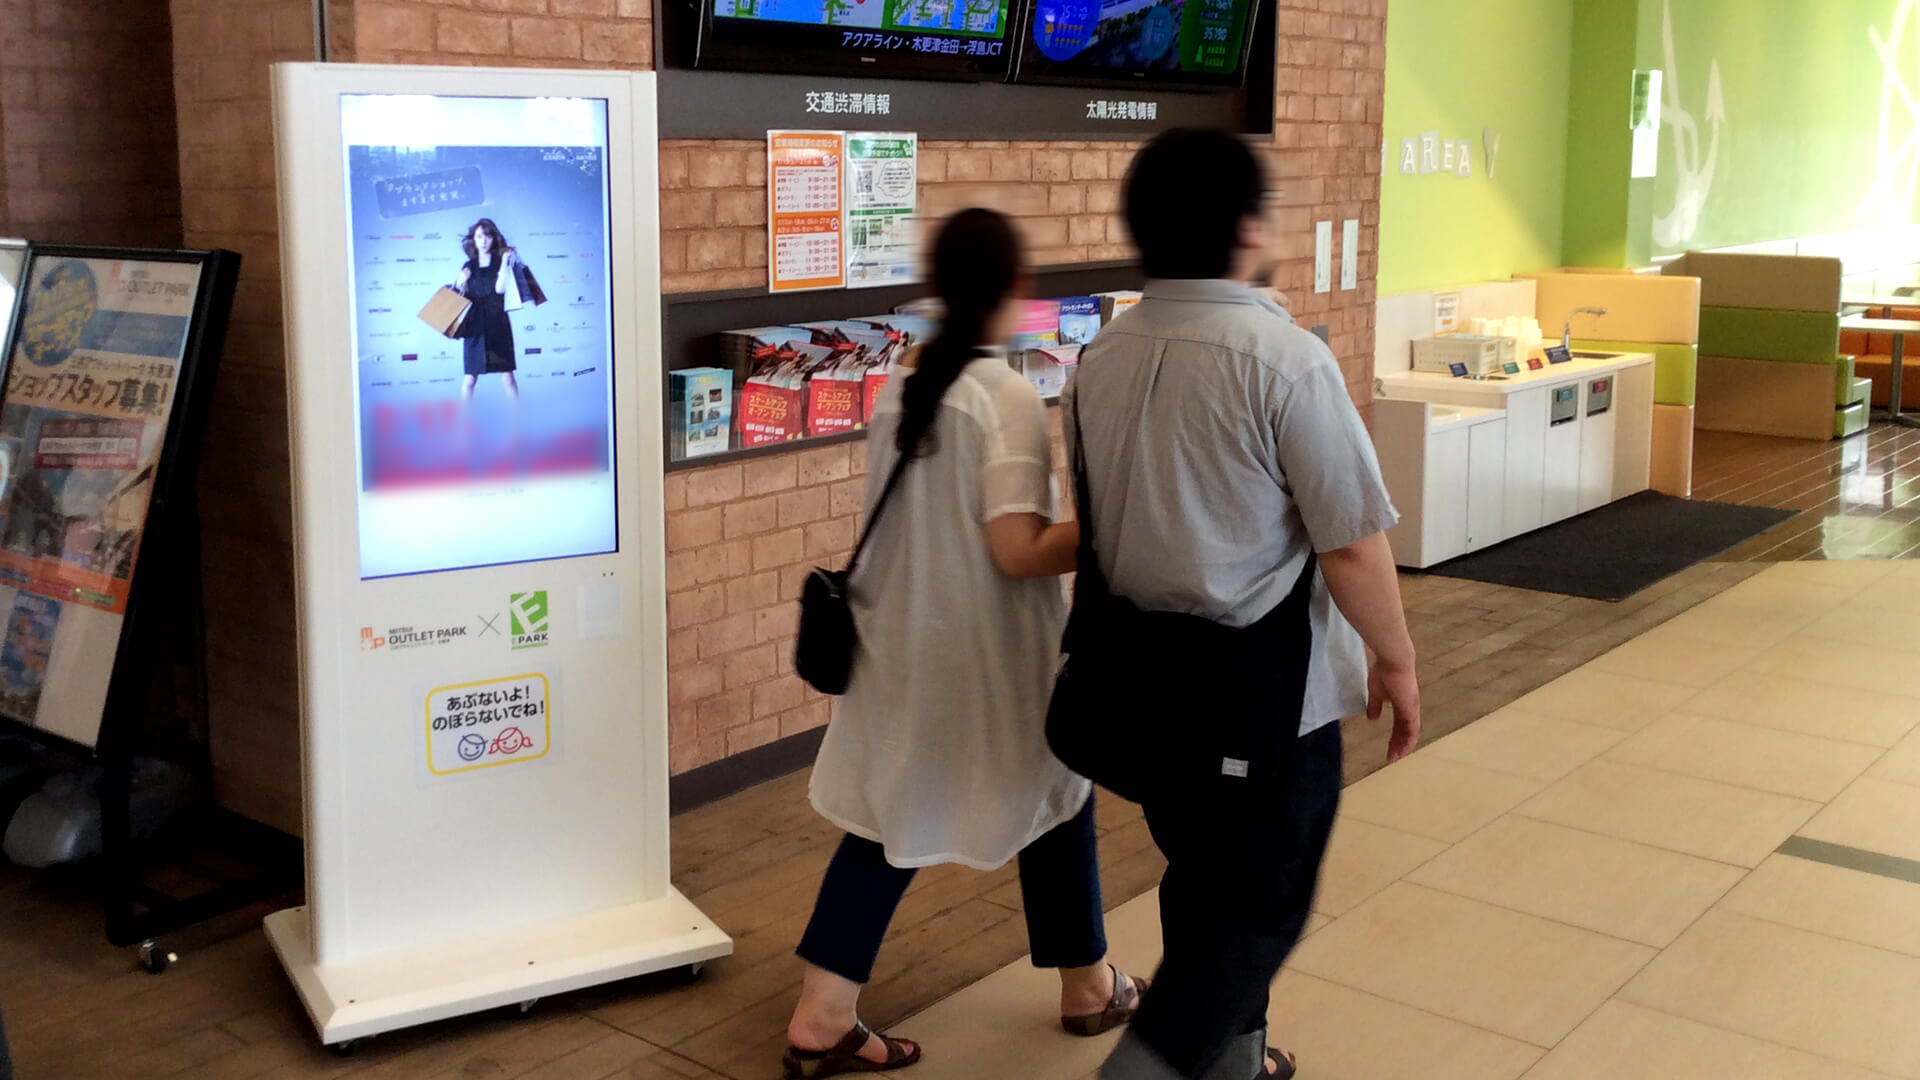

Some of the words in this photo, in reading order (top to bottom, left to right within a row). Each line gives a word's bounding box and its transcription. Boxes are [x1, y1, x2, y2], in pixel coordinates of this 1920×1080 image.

[805, 91, 890, 115] 交通渋滞情報
[1086, 100, 1157, 120] 太陽光発電情報
[1401, 134, 1471, 175] AREA
[388, 630, 435, 645] OUTLET
[436, 626, 466, 638] PARK
[447, 685, 530, 711] あぶないよ！
[432, 700, 545, 731] のぼらないでね！
